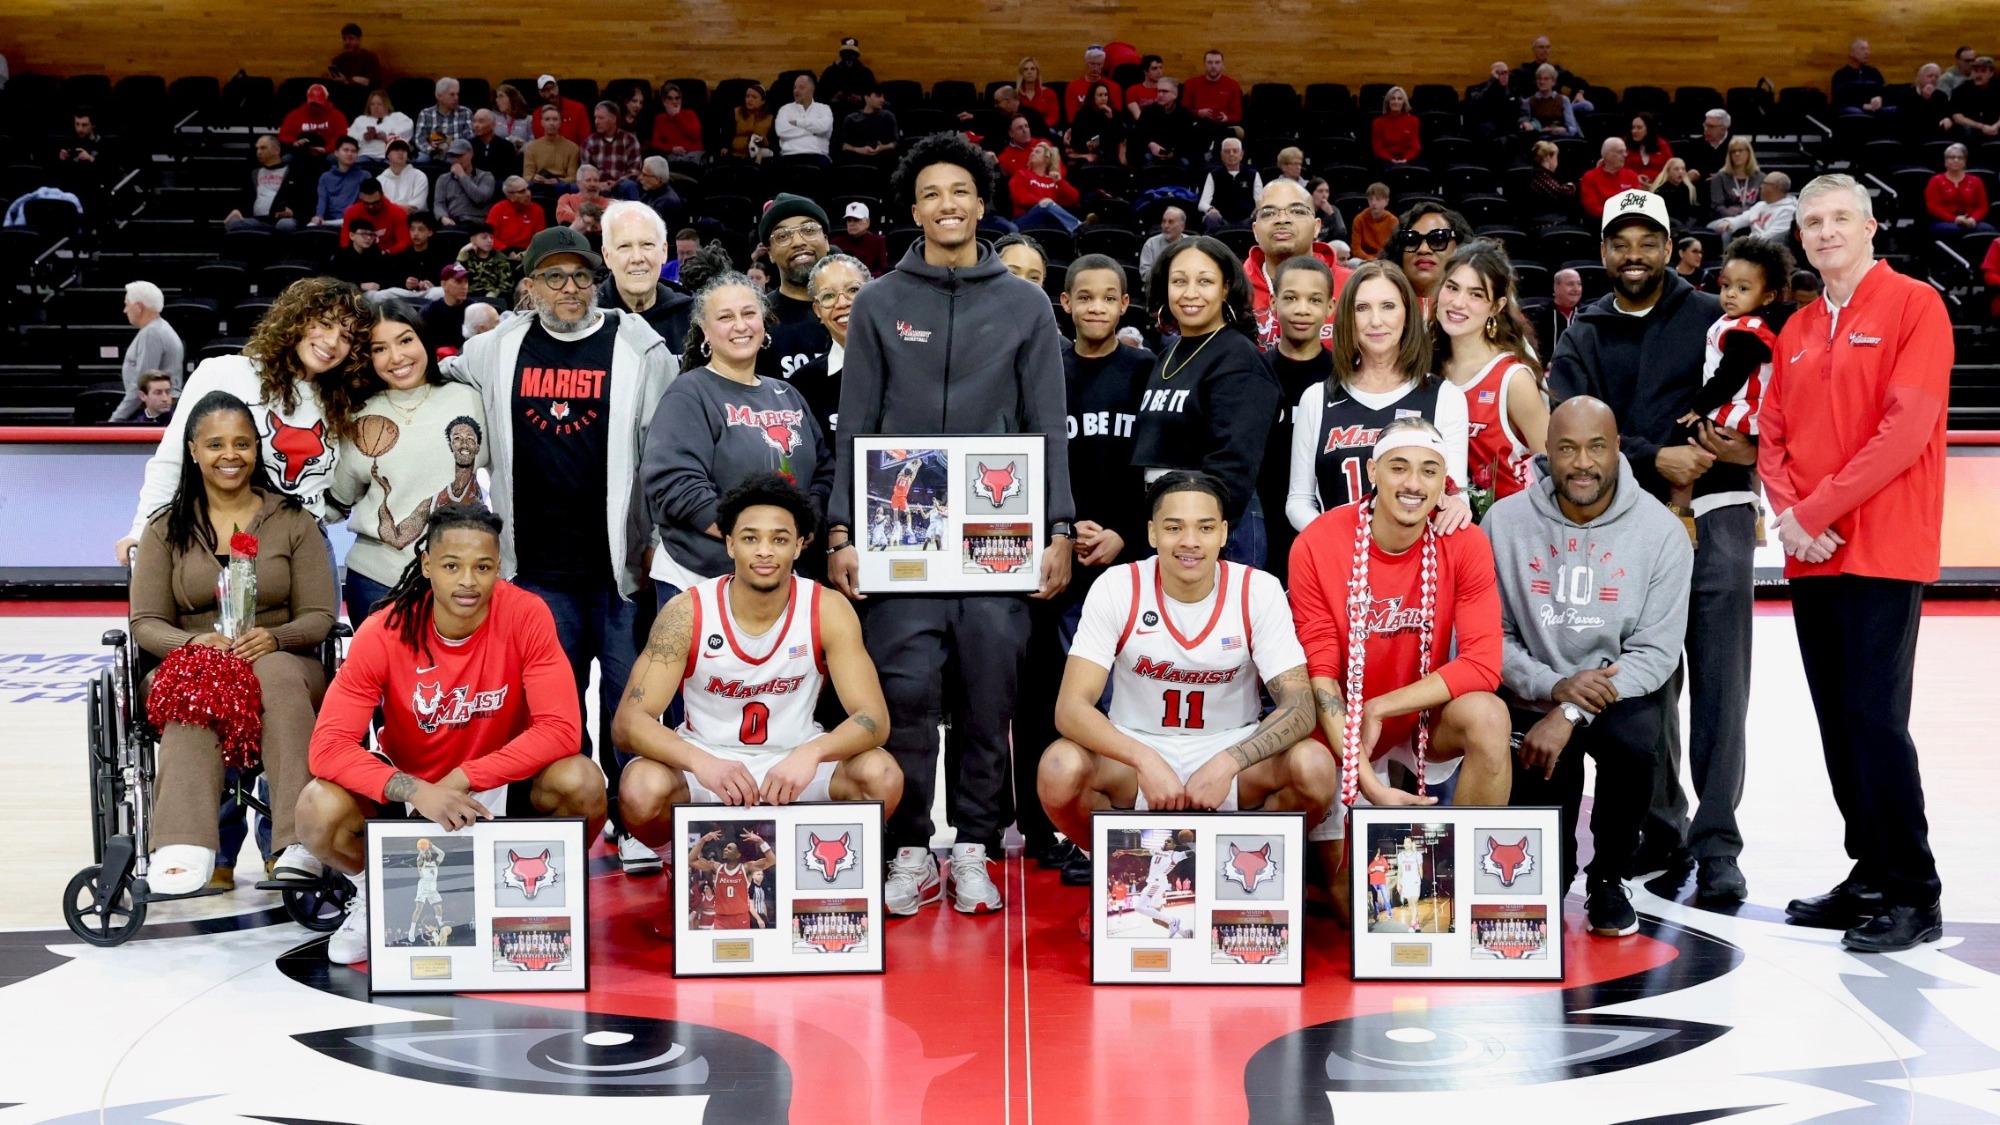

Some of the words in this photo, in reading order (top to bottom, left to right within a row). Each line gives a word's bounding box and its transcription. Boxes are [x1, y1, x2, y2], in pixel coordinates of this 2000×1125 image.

[520, 367, 607, 399] MARIST
[1149, 389, 1171, 412] BE
[1167, 389, 1190, 413] IT
[525, 408, 548, 430] RED
[555, 408, 598, 435] FOXES
[725, 403, 804, 428] MARIST
[1083, 411, 1109, 436] BE
[1113, 412, 1136, 438] IT
[1528, 538, 1626, 577] MARIST
[1555, 565, 1594, 605] 10
[1144, 613, 1157, 623] RP
[1364, 608, 1422, 632] MARIS
[1540, 604, 1566, 627] Red
[1566, 607, 1605, 627] Foxes
[709, 637, 722, 647] RP
[1132, 655, 1241, 685] MARIST
[704, 675, 808, 699] MARIST
[1161, 689, 1204, 729] 11
[739, 701, 770, 745] 0
[726, 886, 734, 898] 0
